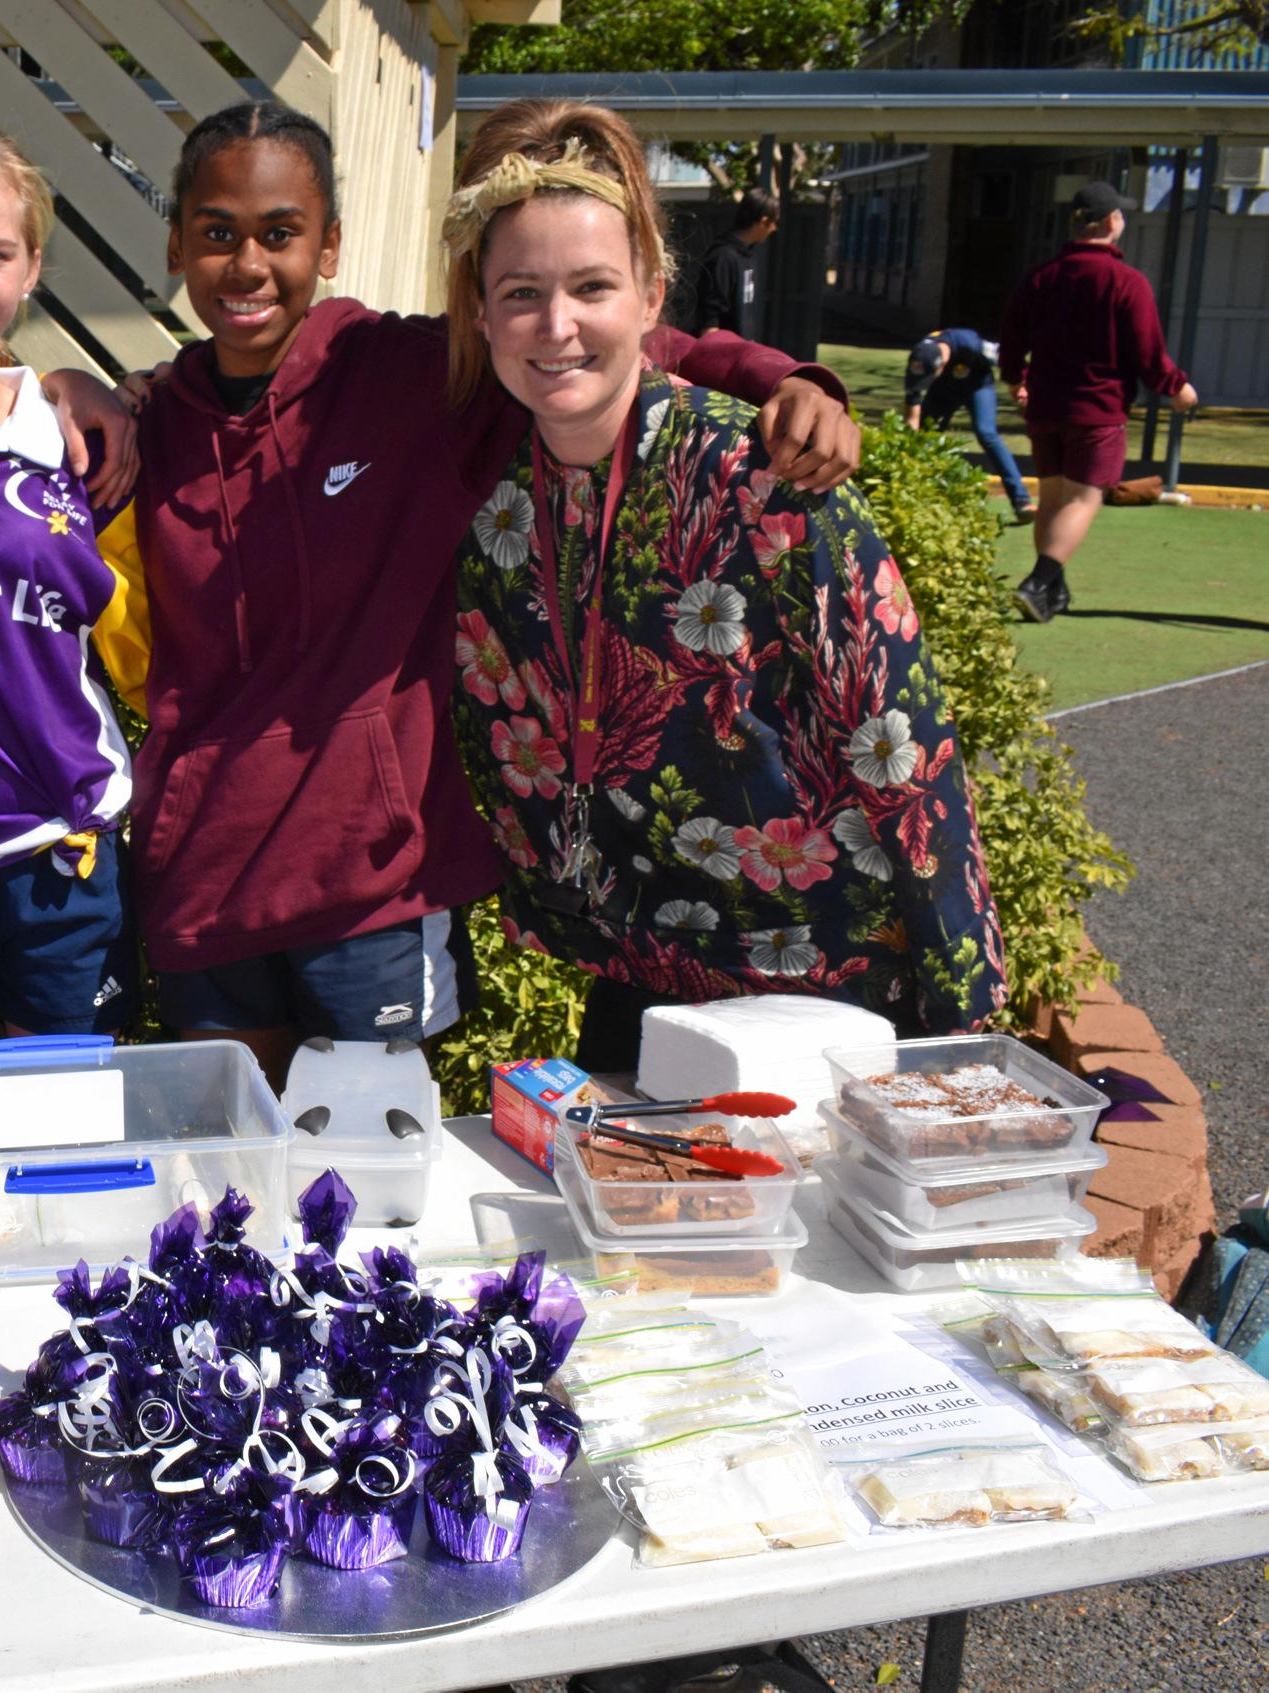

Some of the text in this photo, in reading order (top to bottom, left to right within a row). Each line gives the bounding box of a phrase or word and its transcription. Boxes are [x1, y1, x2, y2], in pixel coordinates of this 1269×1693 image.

[330, 461, 358, 483] NIKE
[804, 1380, 959, 1414] on, Coconut and
[812, 1396, 978, 1431] ndensed milk slice
[841, 1433, 863, 1444] for
[867, 1432, 876, 1441] a
[880, 1427, 908, 1440] bag
[908, 1420, 924, 1433] of
[926, 1422, 936, 1431] 2
[938, 1416, 981, 1430] slices.
